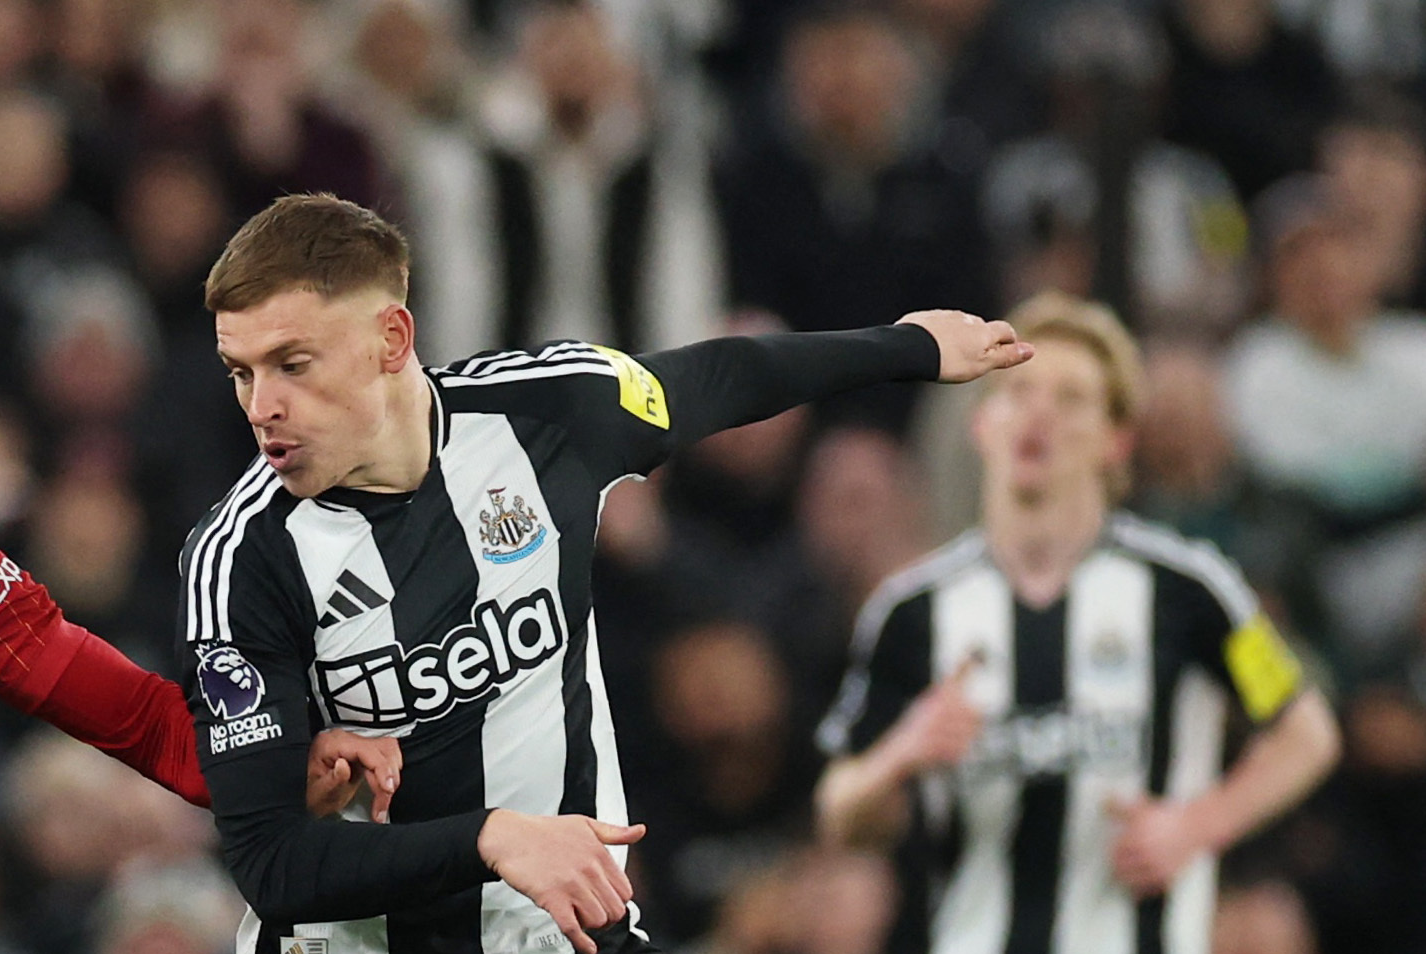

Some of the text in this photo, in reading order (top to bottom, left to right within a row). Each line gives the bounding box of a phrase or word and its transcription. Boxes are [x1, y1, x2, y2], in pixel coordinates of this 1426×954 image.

[408, 597, 557, 711] sela
[209, 713, 272, 740] No room
[210, 724, 283, 755] for racism
